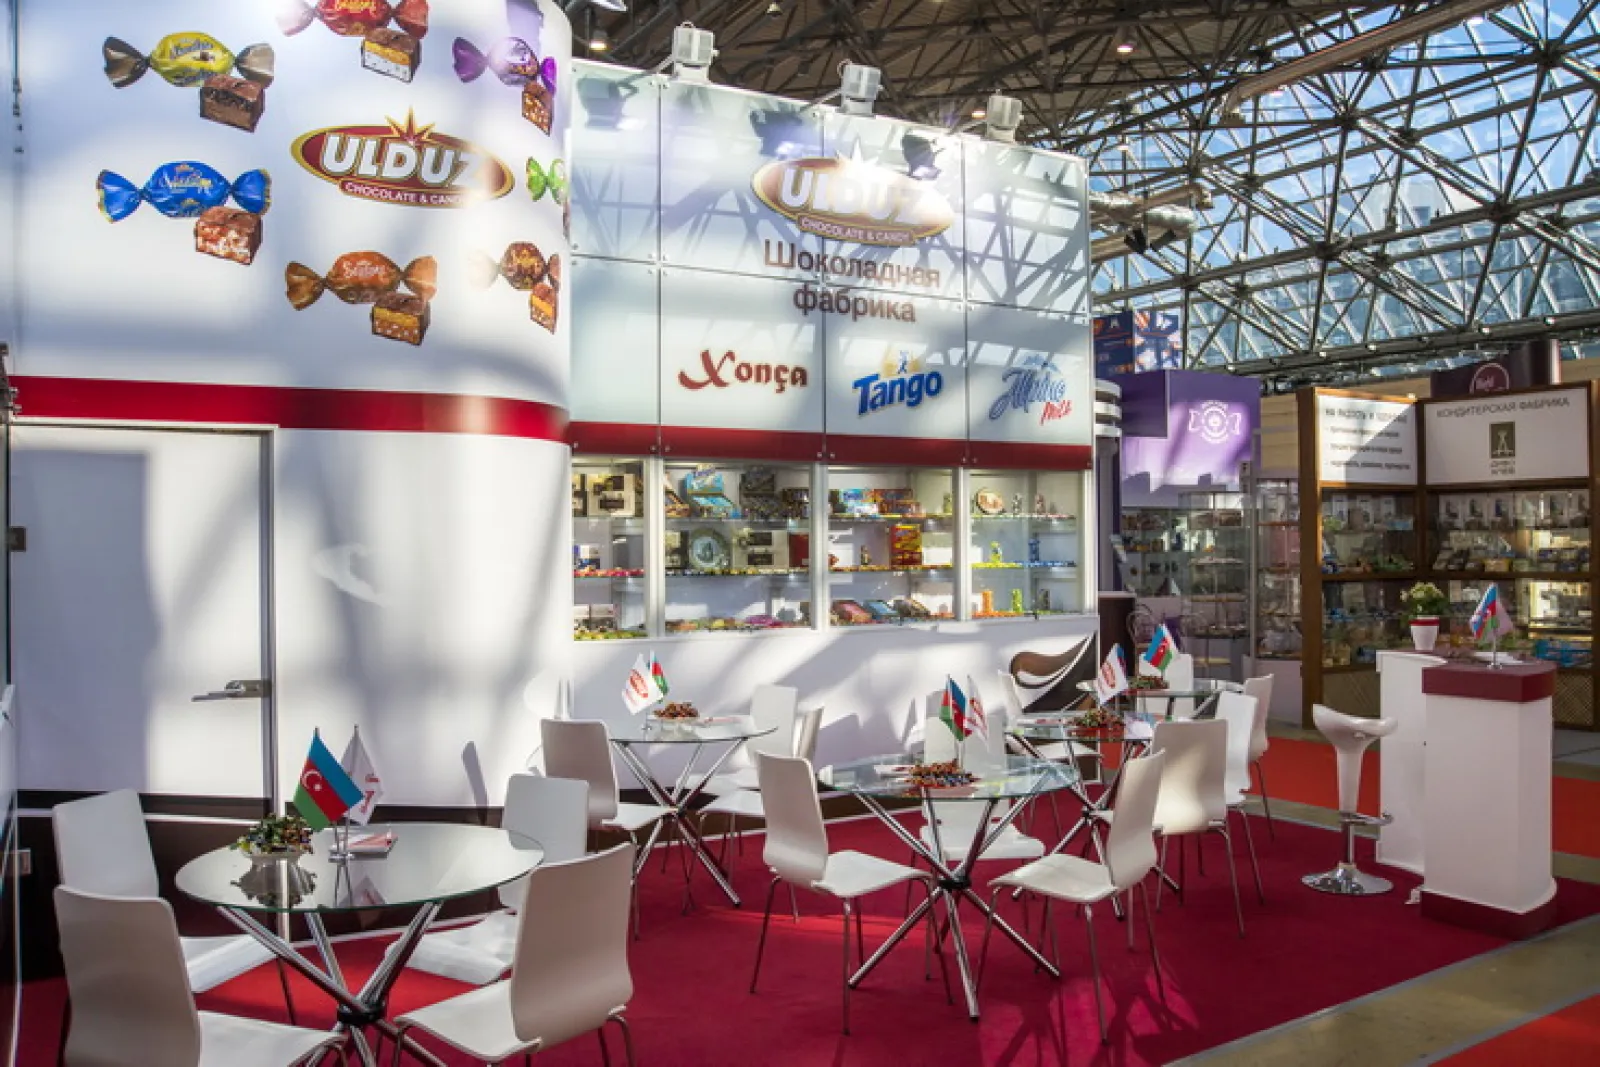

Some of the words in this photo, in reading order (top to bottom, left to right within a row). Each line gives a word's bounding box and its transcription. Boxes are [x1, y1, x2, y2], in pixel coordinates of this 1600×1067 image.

[322, 132, 484, 190] ULDUZ
[345, 181, 416, 203] CHOCOLATE
[801, 216, 865, 240] CHOCOLATE
[867, 229, 875, 241] &
[876, 230, 910, 243] CANDY
[764, 238, 941, 288] Шоколадная
[793, 282, 916, 323] фабрика
[677, 349, 808, 393] Xonça
[852, 371, 943, 416] Tango
[1435, 401, 1516, 419] КОНДИТЕРСКАЯ
[1518, 397, 1571, 410] ФАБРИКА
